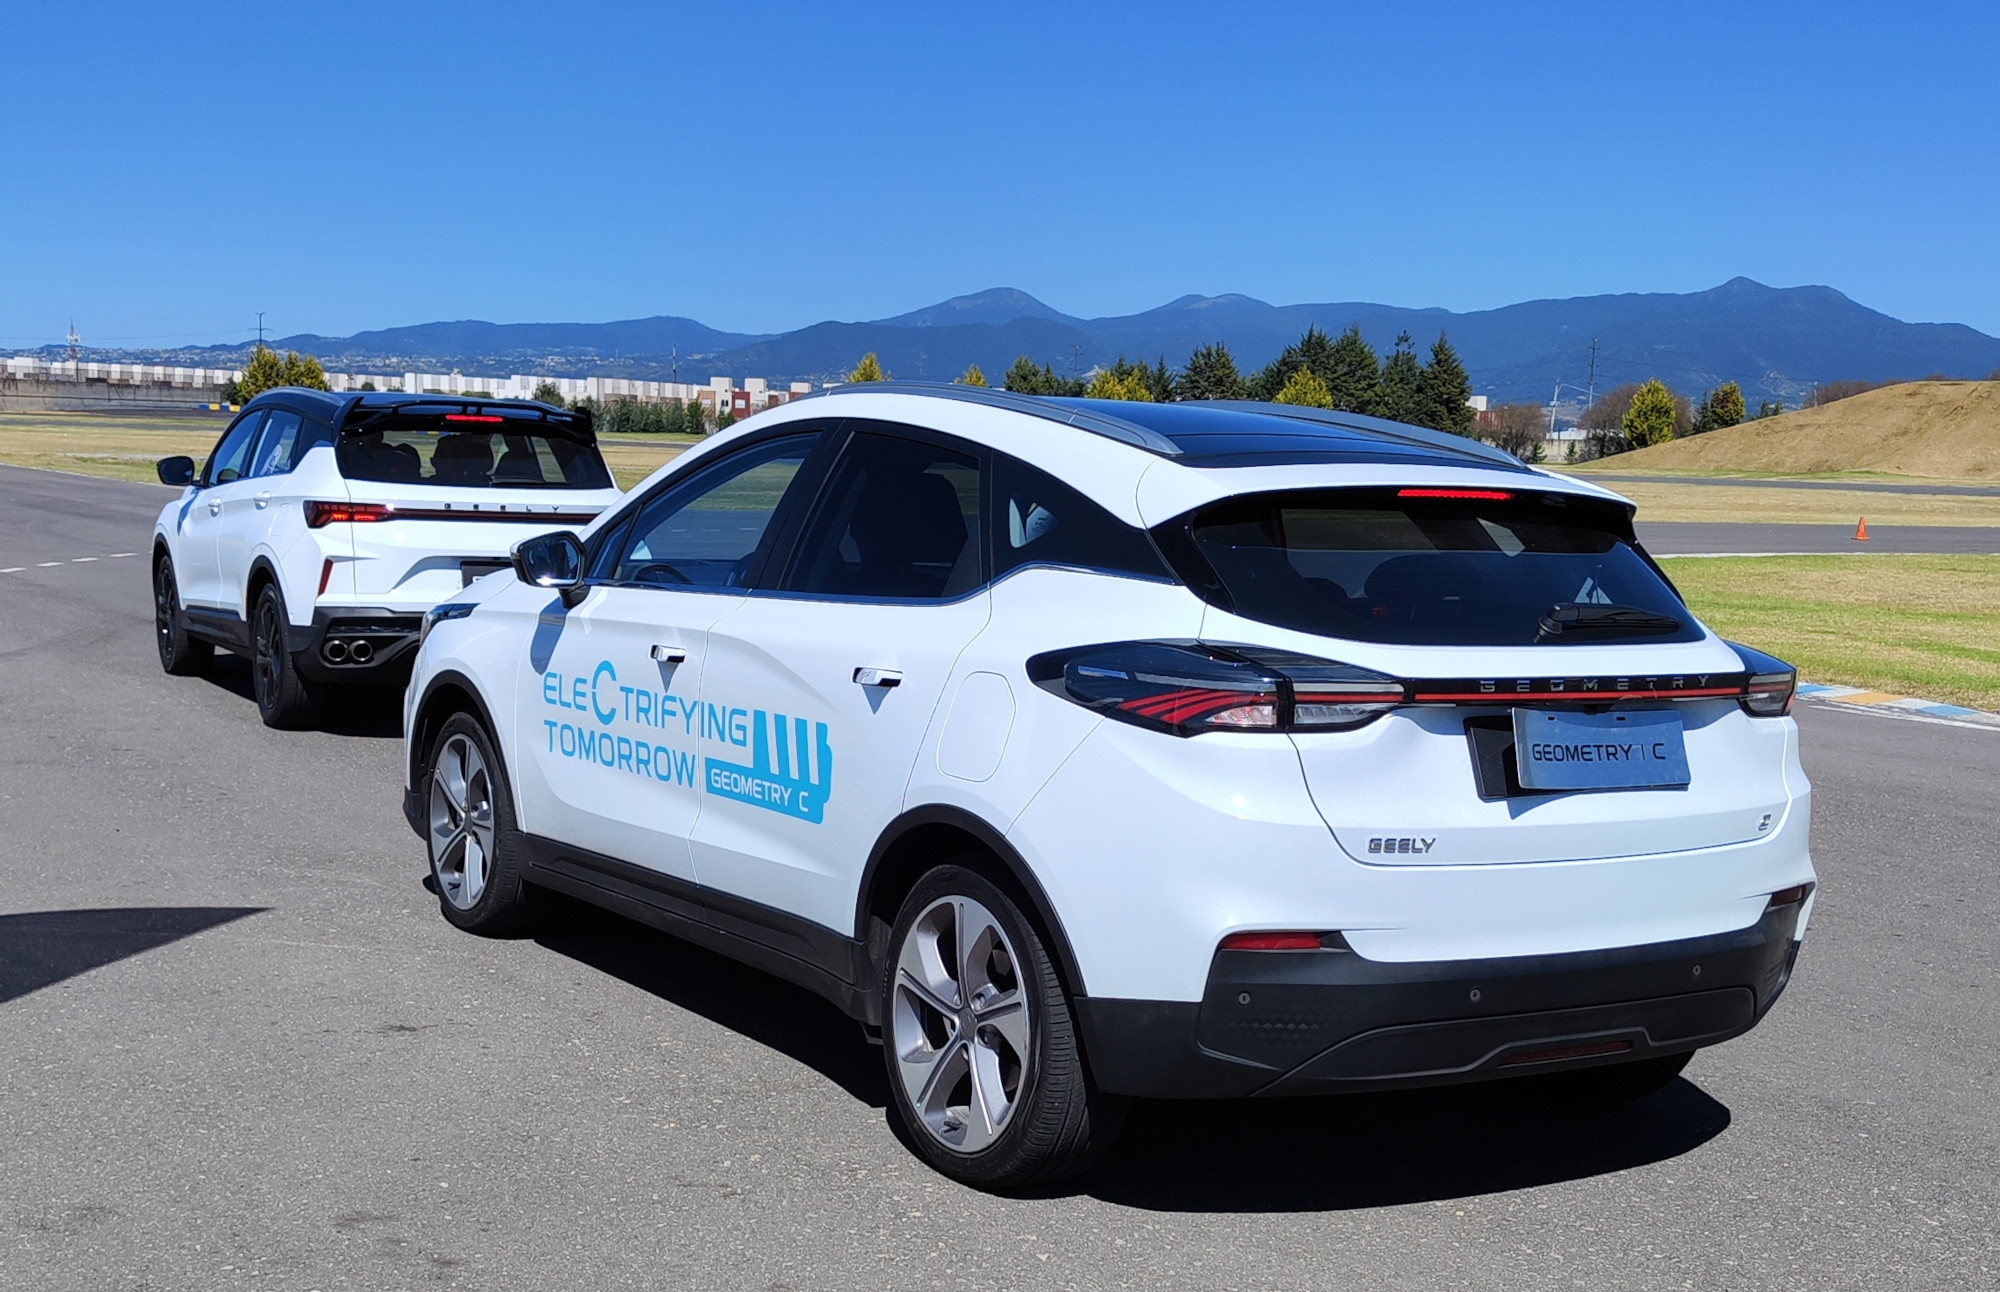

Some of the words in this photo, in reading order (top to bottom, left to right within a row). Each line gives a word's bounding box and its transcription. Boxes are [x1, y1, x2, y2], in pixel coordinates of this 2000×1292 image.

[1480, 675, 1709, 693] GEOMETRY
[543, 660, 748, 747] ELECTRIFYING
[543, 719, 696, 789] TOMORROW
[1532, 743, 1632, 762] GEOMETRY
[1653, 742, 1666, 760] C
[710, 768, 792, 807] GEOMETRY
[799, 791, 809, 812] C
[1367, 837, 1437, 854] GEELY
